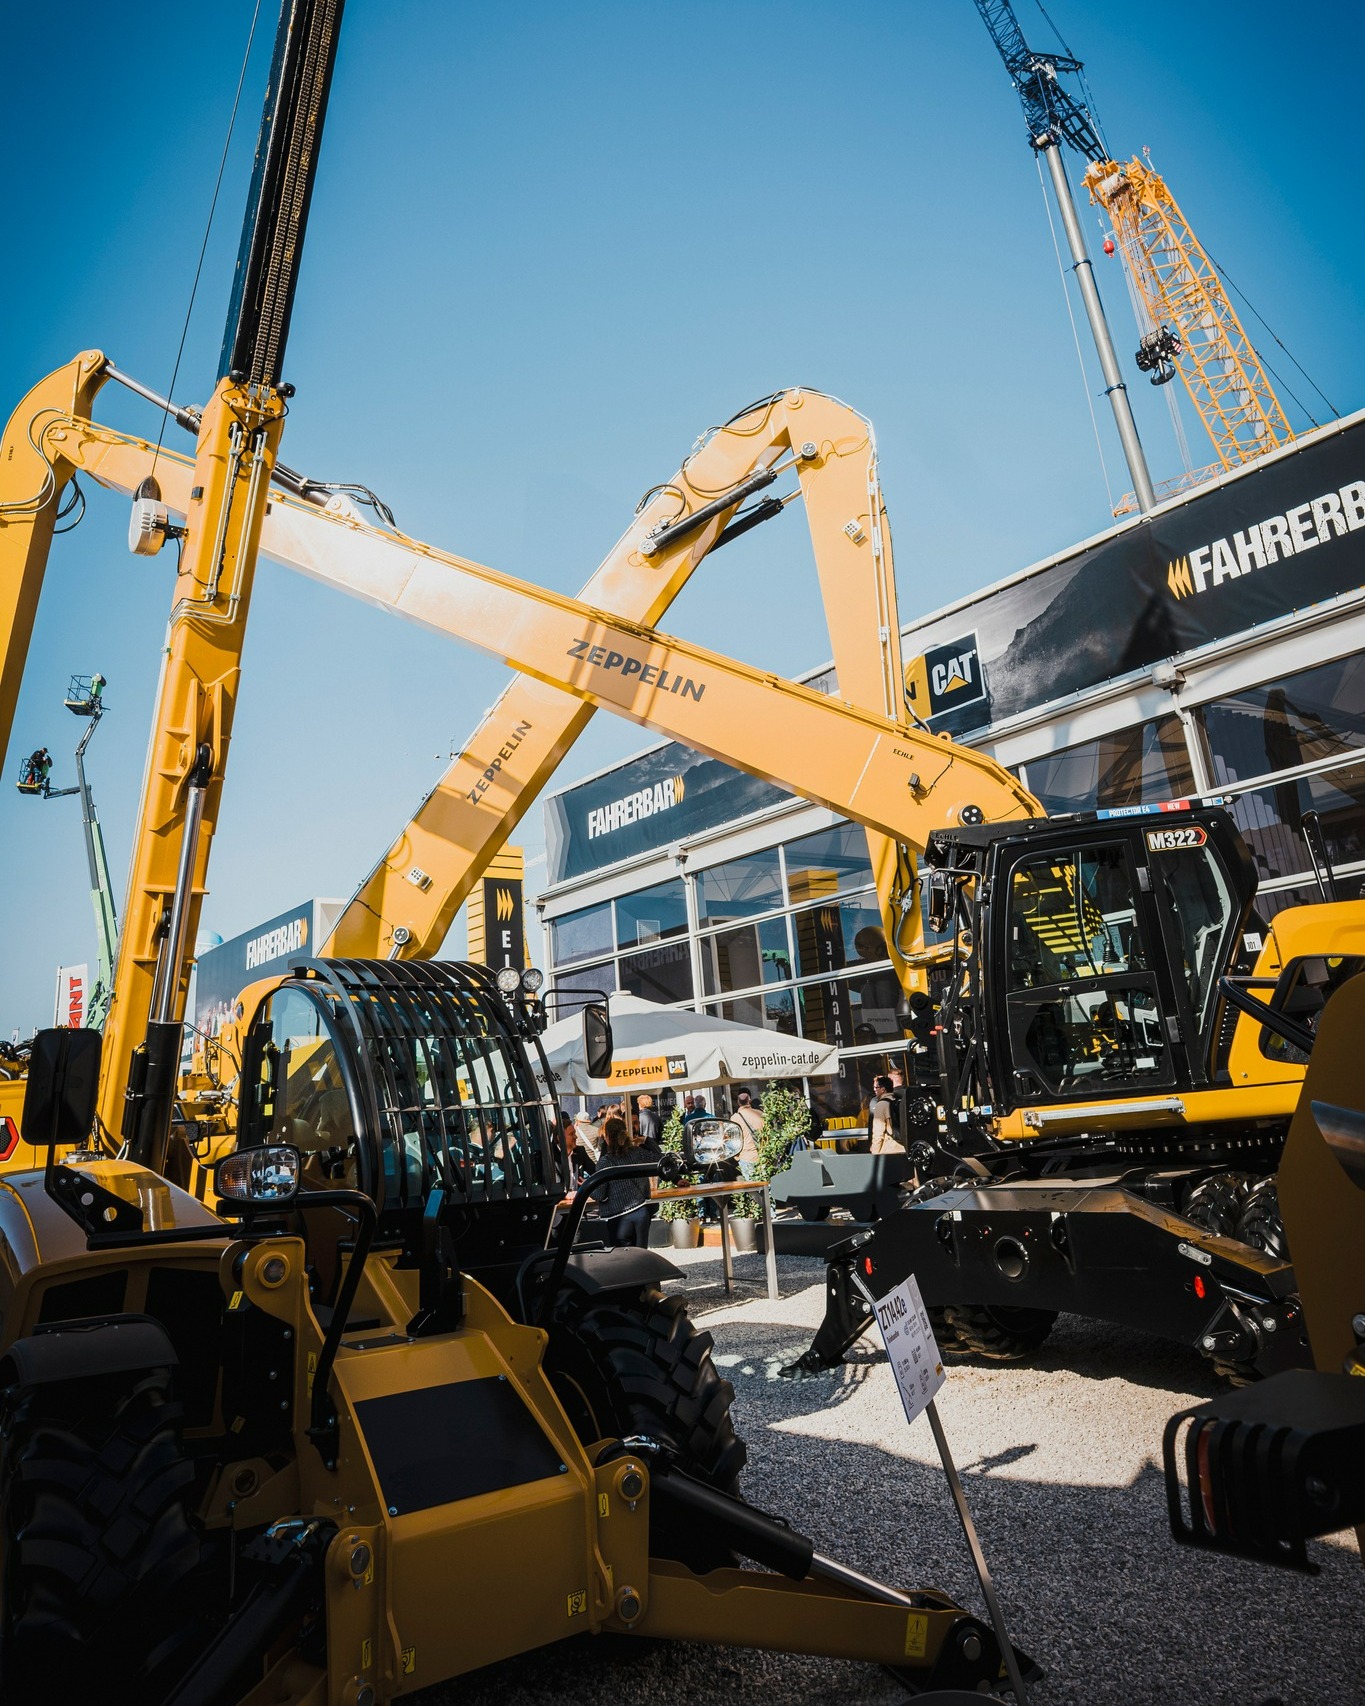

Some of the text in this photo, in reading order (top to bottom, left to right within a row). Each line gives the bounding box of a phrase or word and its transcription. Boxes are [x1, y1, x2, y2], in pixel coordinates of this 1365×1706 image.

[1189, 480, 1365, 594] FAHRERB
[567, 638, 706, 702] ZEPPELIN
[931, 650, 973, 696] CAT
[466, 719, 532, 805] ZEPPELIN
[588, 778, 675, 839] FAHRERBAR
[1109, 806, 1142, 817] PROTECTOR
[1167, 802, 1181, 811] NEW
[1148, 829, 1197, 850] M322
[246, 919, 301, 971] FAHRERBAR
[615, 1059, 686, 1078] ZEPPELIN CAT
[742, 1052, 820, 1070] zeppelin-cat.de
